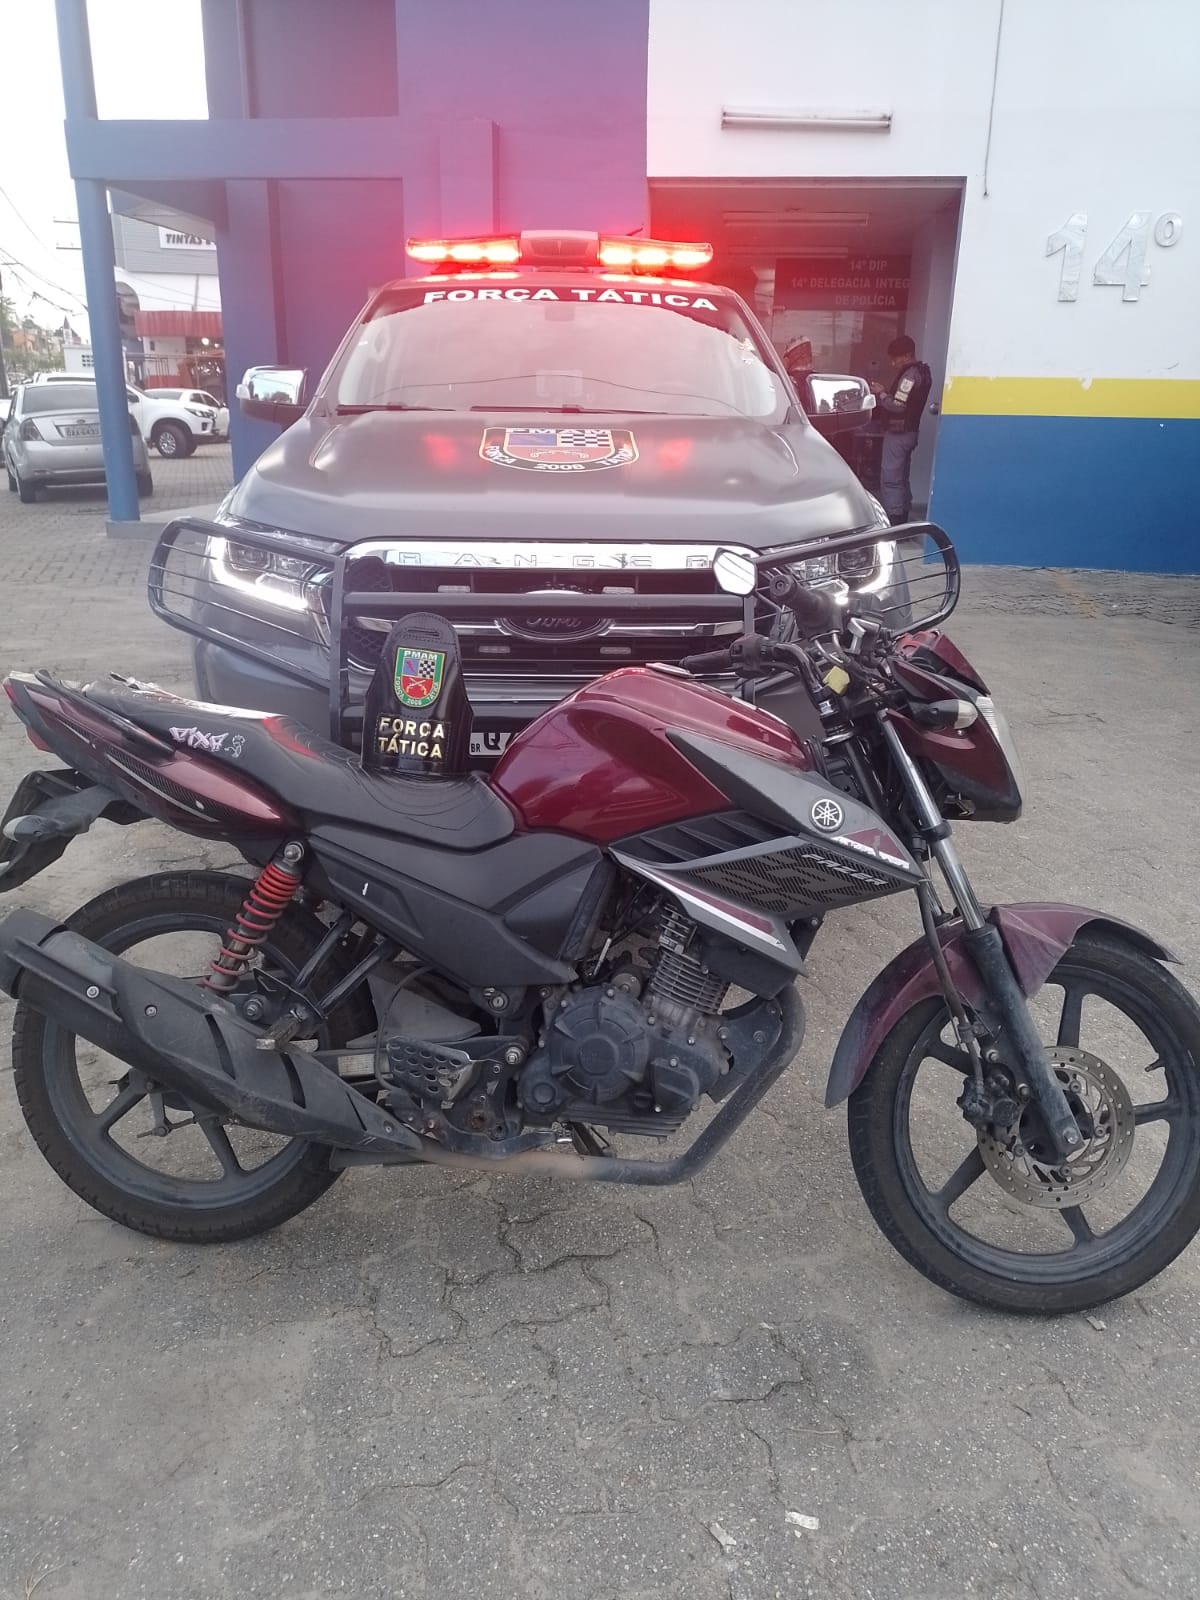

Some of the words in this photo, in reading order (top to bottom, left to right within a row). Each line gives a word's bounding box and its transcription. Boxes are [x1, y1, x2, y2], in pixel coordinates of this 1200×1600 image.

[869, 260, 888, 271] DIP
[810, 278, 871, 289] DELEGACIA
[423, 288, 560, 304] FORÇA
[571, 288, 719, 311] TÁTICA
[835, 295, 850, 305] DE
[852, 292, 896, 306] POLÍCIA
[399, 551, 713, 569] RANGER
[404, 650, 438, 661] PMAM
[379, 717, 446, 739] FORÇA
[378, 734, 443, 759] TÁTICA
[471, 743, 481, 753] BR
[801, 853, 889, 886] FAZER
